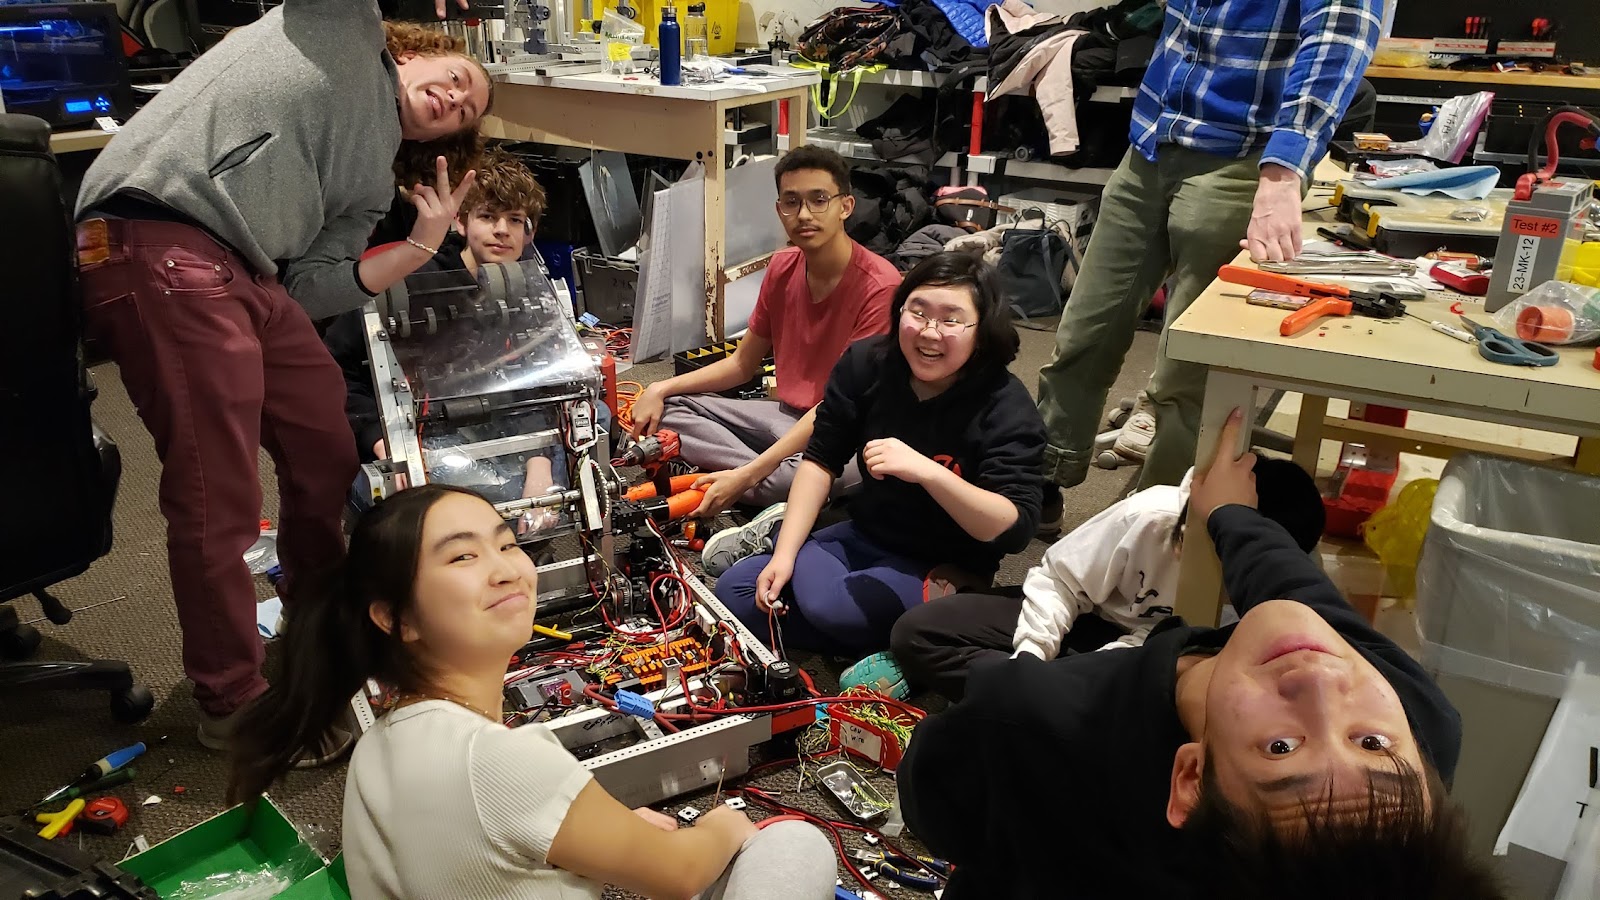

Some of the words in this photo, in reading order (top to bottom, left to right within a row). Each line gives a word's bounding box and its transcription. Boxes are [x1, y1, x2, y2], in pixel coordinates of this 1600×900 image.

[1513, 218, 1539, 232] Test
[1541, 222, 1558, 234] #2
[1512, 237, 1535, 291] 23-MK-12
